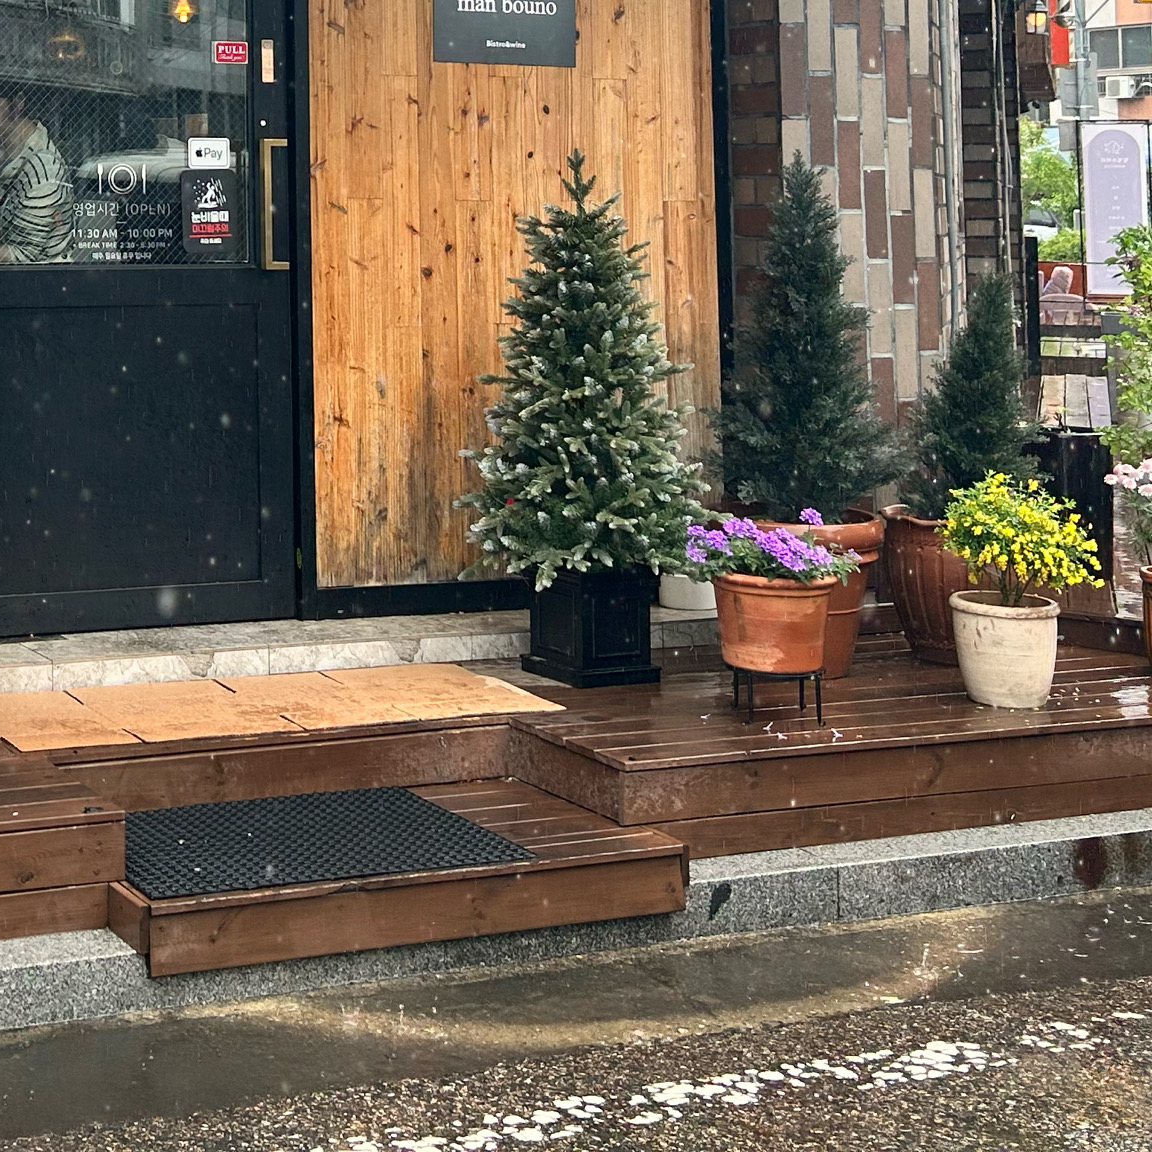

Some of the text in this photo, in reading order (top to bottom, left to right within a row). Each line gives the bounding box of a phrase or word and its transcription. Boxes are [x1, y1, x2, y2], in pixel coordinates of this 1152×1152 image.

[486, 40, 526, 49] Bistro&wine
[218, 45, 245, 54] PULL
[204, 148, 223, 160] Pay
[73, 202, 171, 217] 영업시간 (OPEN)
[72, 228, 100, 238] 11:30
[102, 228, 118, 238] AM
[128, 228, 156, 238] 10:00
[158, 228, 173, 238] PM
[78, 241, 101, 249] BREAK
